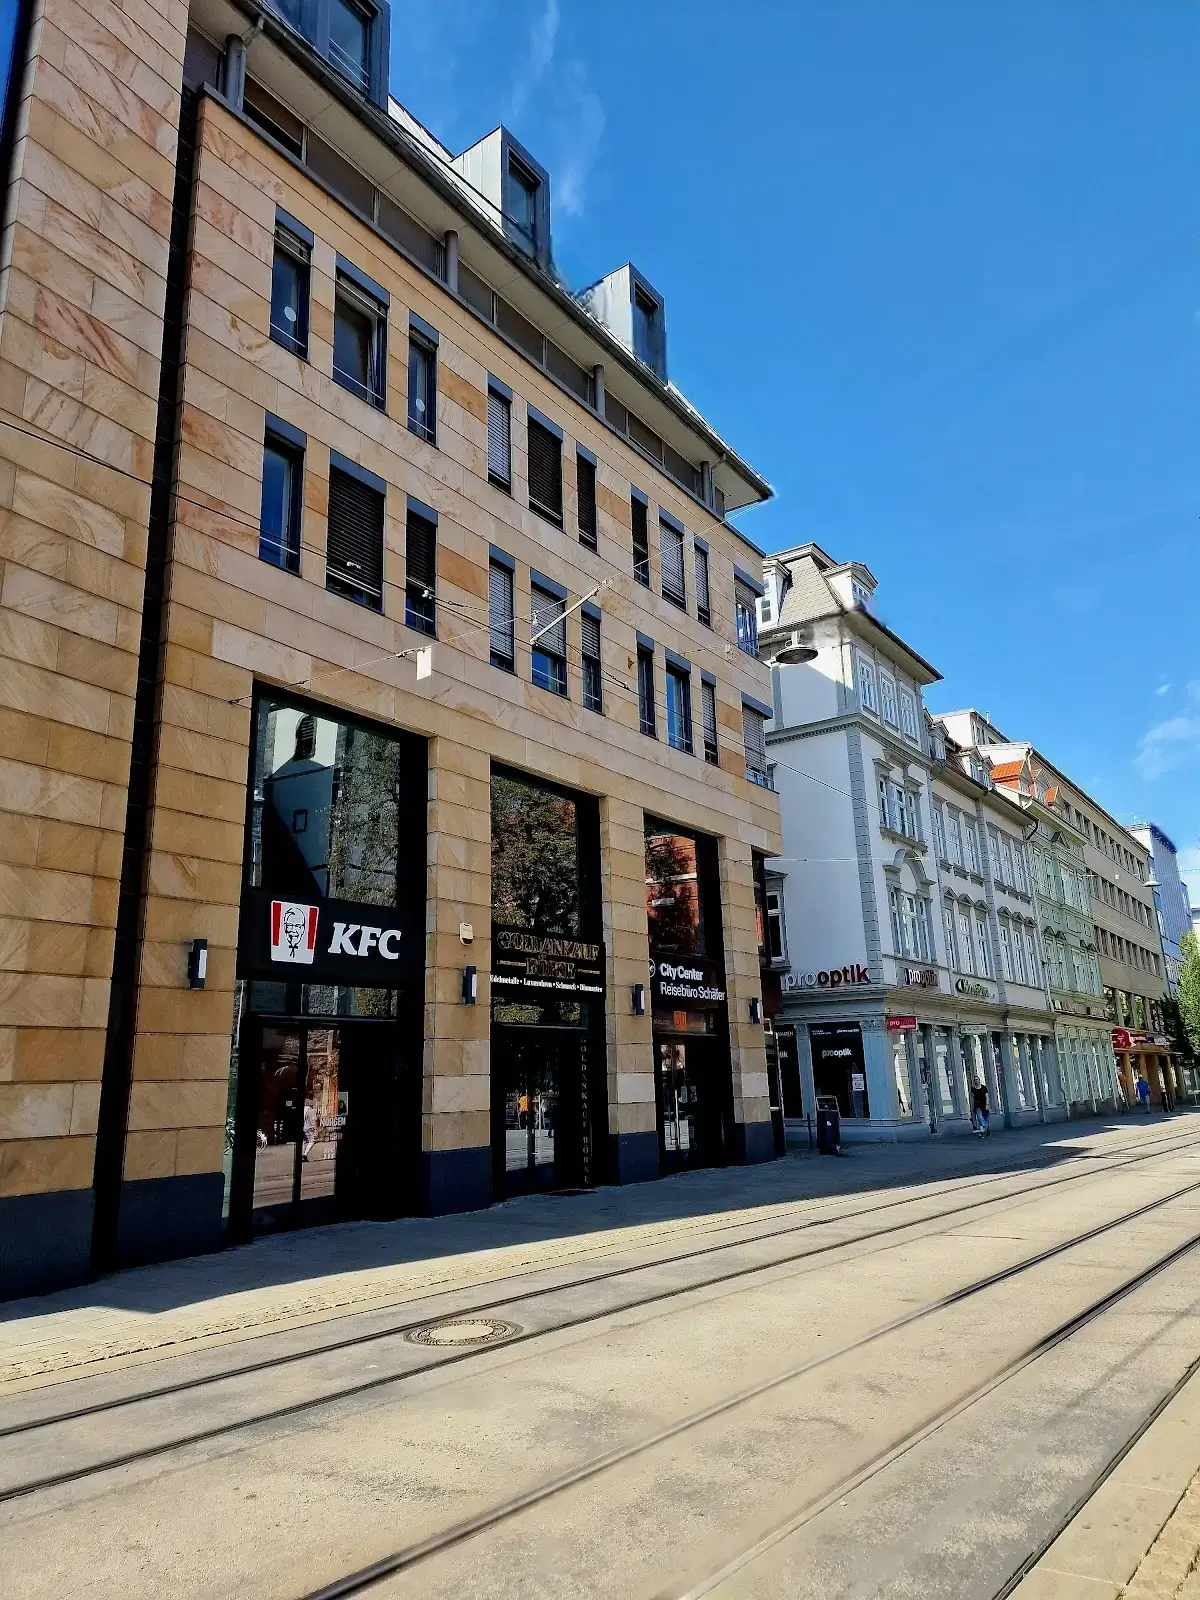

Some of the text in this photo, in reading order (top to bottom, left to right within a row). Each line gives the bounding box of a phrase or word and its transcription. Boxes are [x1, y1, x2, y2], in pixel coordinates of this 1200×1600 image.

[328, 921, 402, 960] KFC
[497, 931, 600, 961] GOLDANKAUF
[660, 962, 704, 981] City Center
[783, 963, 871, 989] prooptik
[660, 981, 725, 1001] Reisebüro Schäfer
[821, 1047, 852, 1058] prooptik
